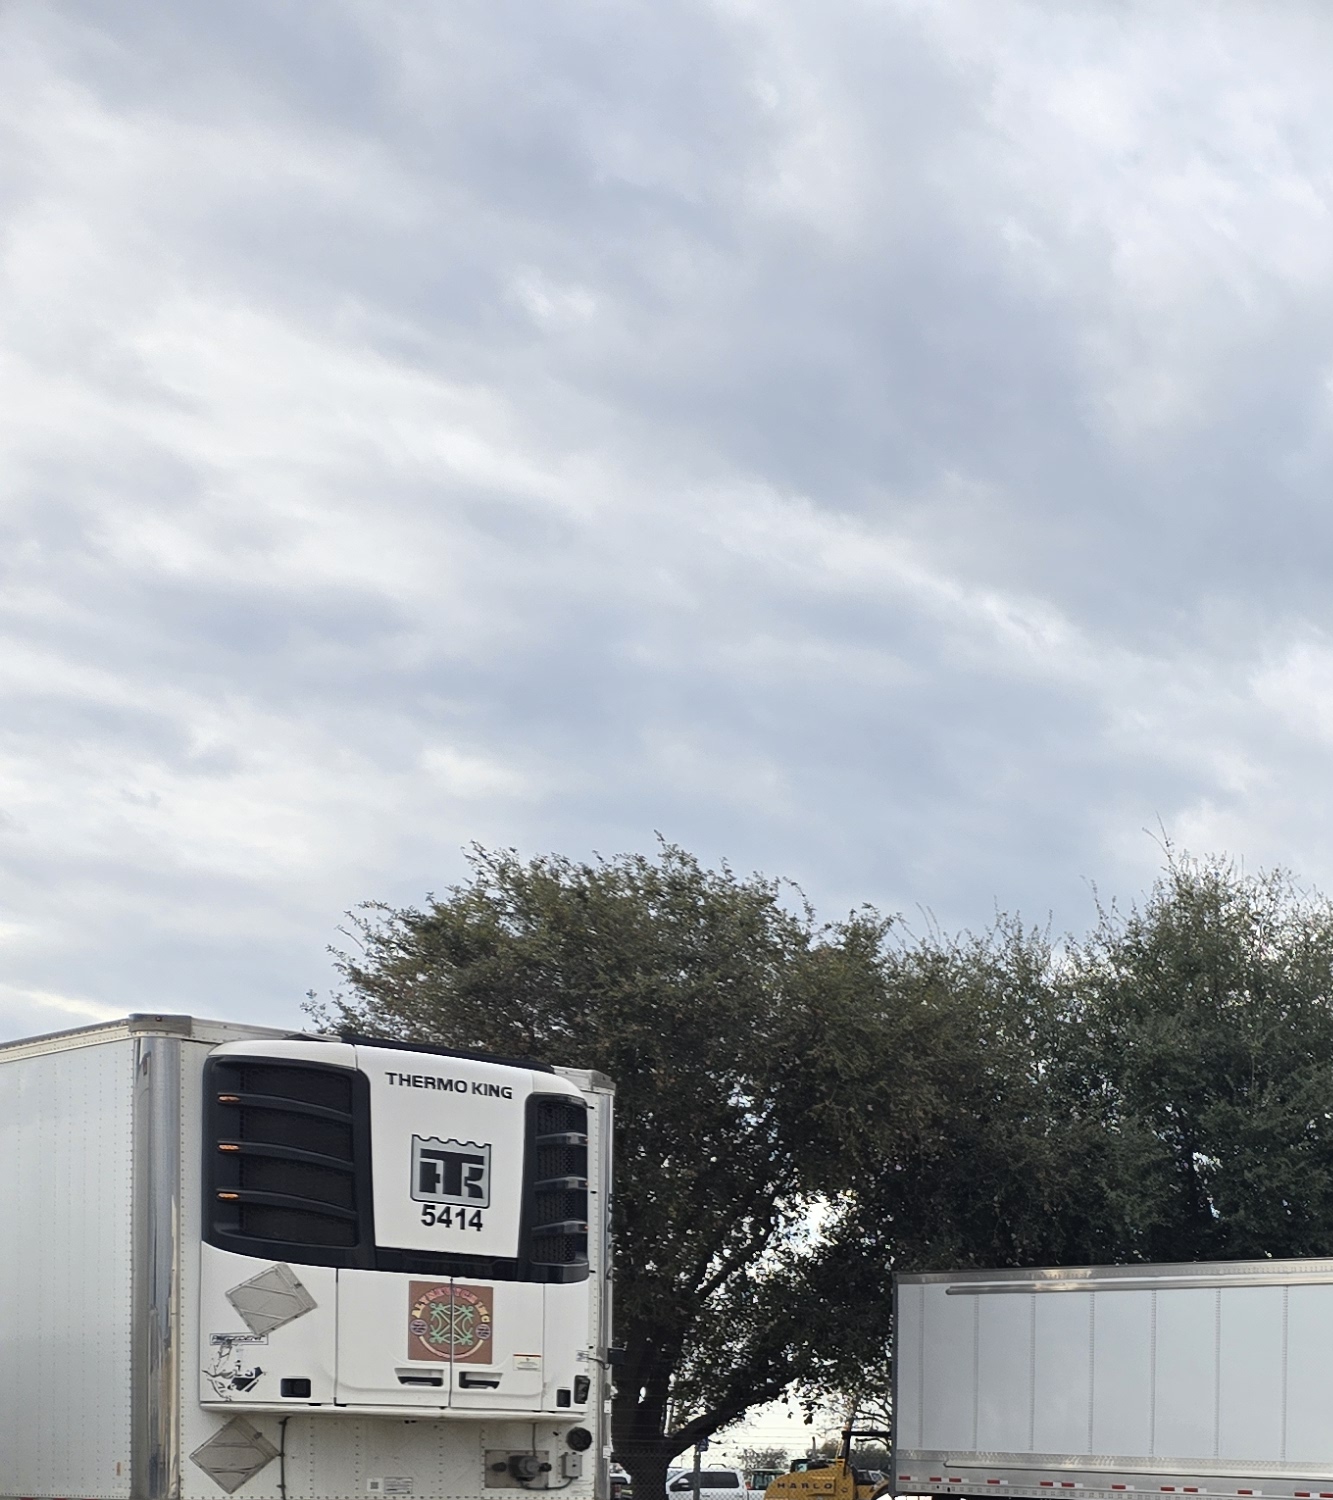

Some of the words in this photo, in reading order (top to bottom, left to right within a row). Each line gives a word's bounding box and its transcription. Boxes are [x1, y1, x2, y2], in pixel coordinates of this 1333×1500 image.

[384, 1071, 468, 1094] THERMO
[471, 1081, 513, 1100] KING
[420, 1203, 484, 1232] 5414
[777, 1482, 833, 1490] HARLO
